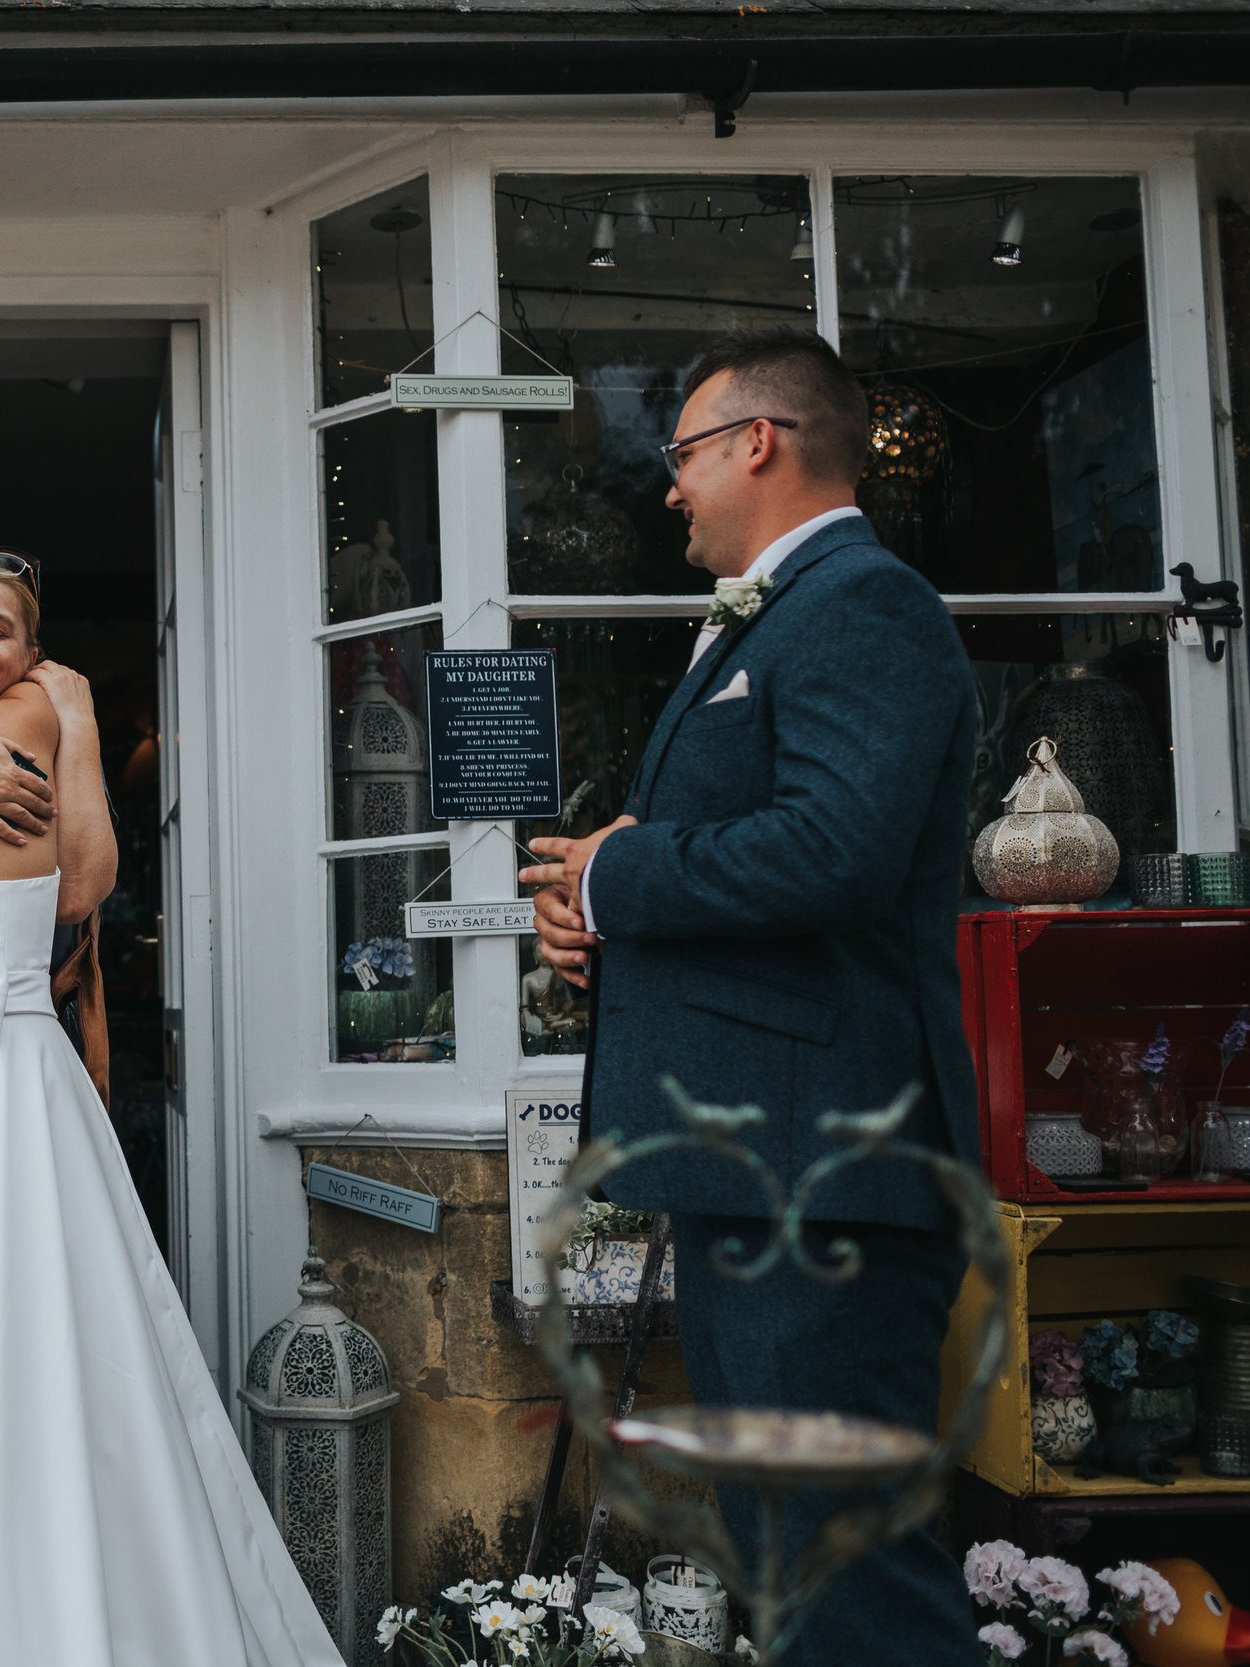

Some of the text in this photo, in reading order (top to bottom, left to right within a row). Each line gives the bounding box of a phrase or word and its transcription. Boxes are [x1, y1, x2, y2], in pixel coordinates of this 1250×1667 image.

[399, 385, 568, 397] SEX, DRUGS AND SAUSAGE ROLLS!
[434, 656, 547, 668] RULES FOR DATING
[446, 671, 536, 683] MY DAUGHTER
[510, 795, 521, 803] DO
[522, 795, 532, 803] TO
[468, 804, 488, 812] WILL
[488, 804, 499, 812] DO
[500, 804, 511, 812] TO
[420, 909, 451, 917] SKINNY
[452, 908, 484, 916] PEOPLE
[427, 918, 458, 928] STAY
[462, 917, 500, 927] SAFE,
[504, 915, 529, 926] EAT
[542, 1157, 555, 1166] The
[328, 1179, 413, 1215] NO RIFF RAFF
